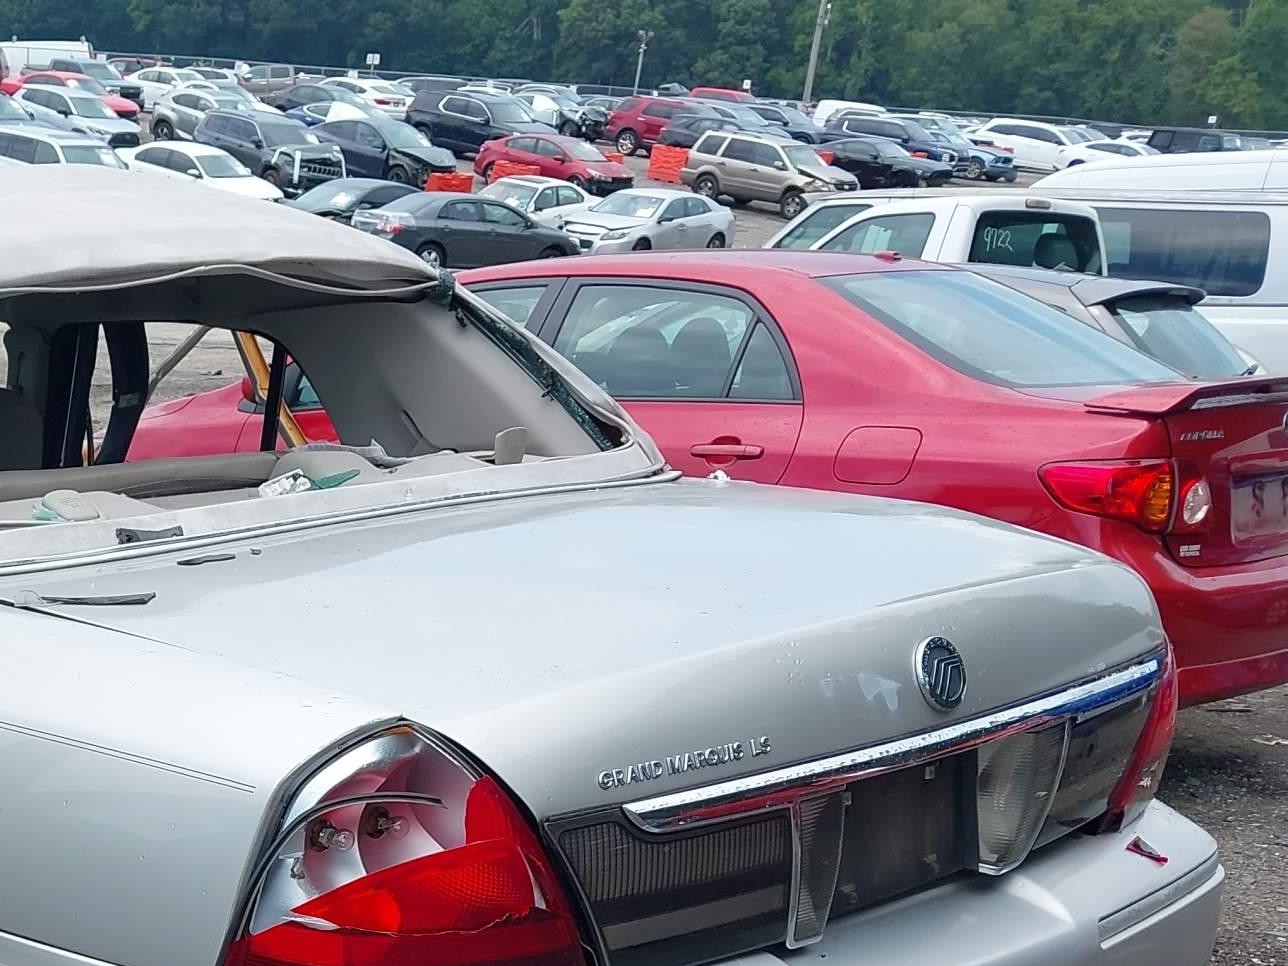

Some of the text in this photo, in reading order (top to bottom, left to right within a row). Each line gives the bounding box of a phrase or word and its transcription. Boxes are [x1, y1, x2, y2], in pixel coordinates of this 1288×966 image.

[983, 226, 1013, 252] 9722
[598, 735, 771, 790] GRAND MARQUIS LS
